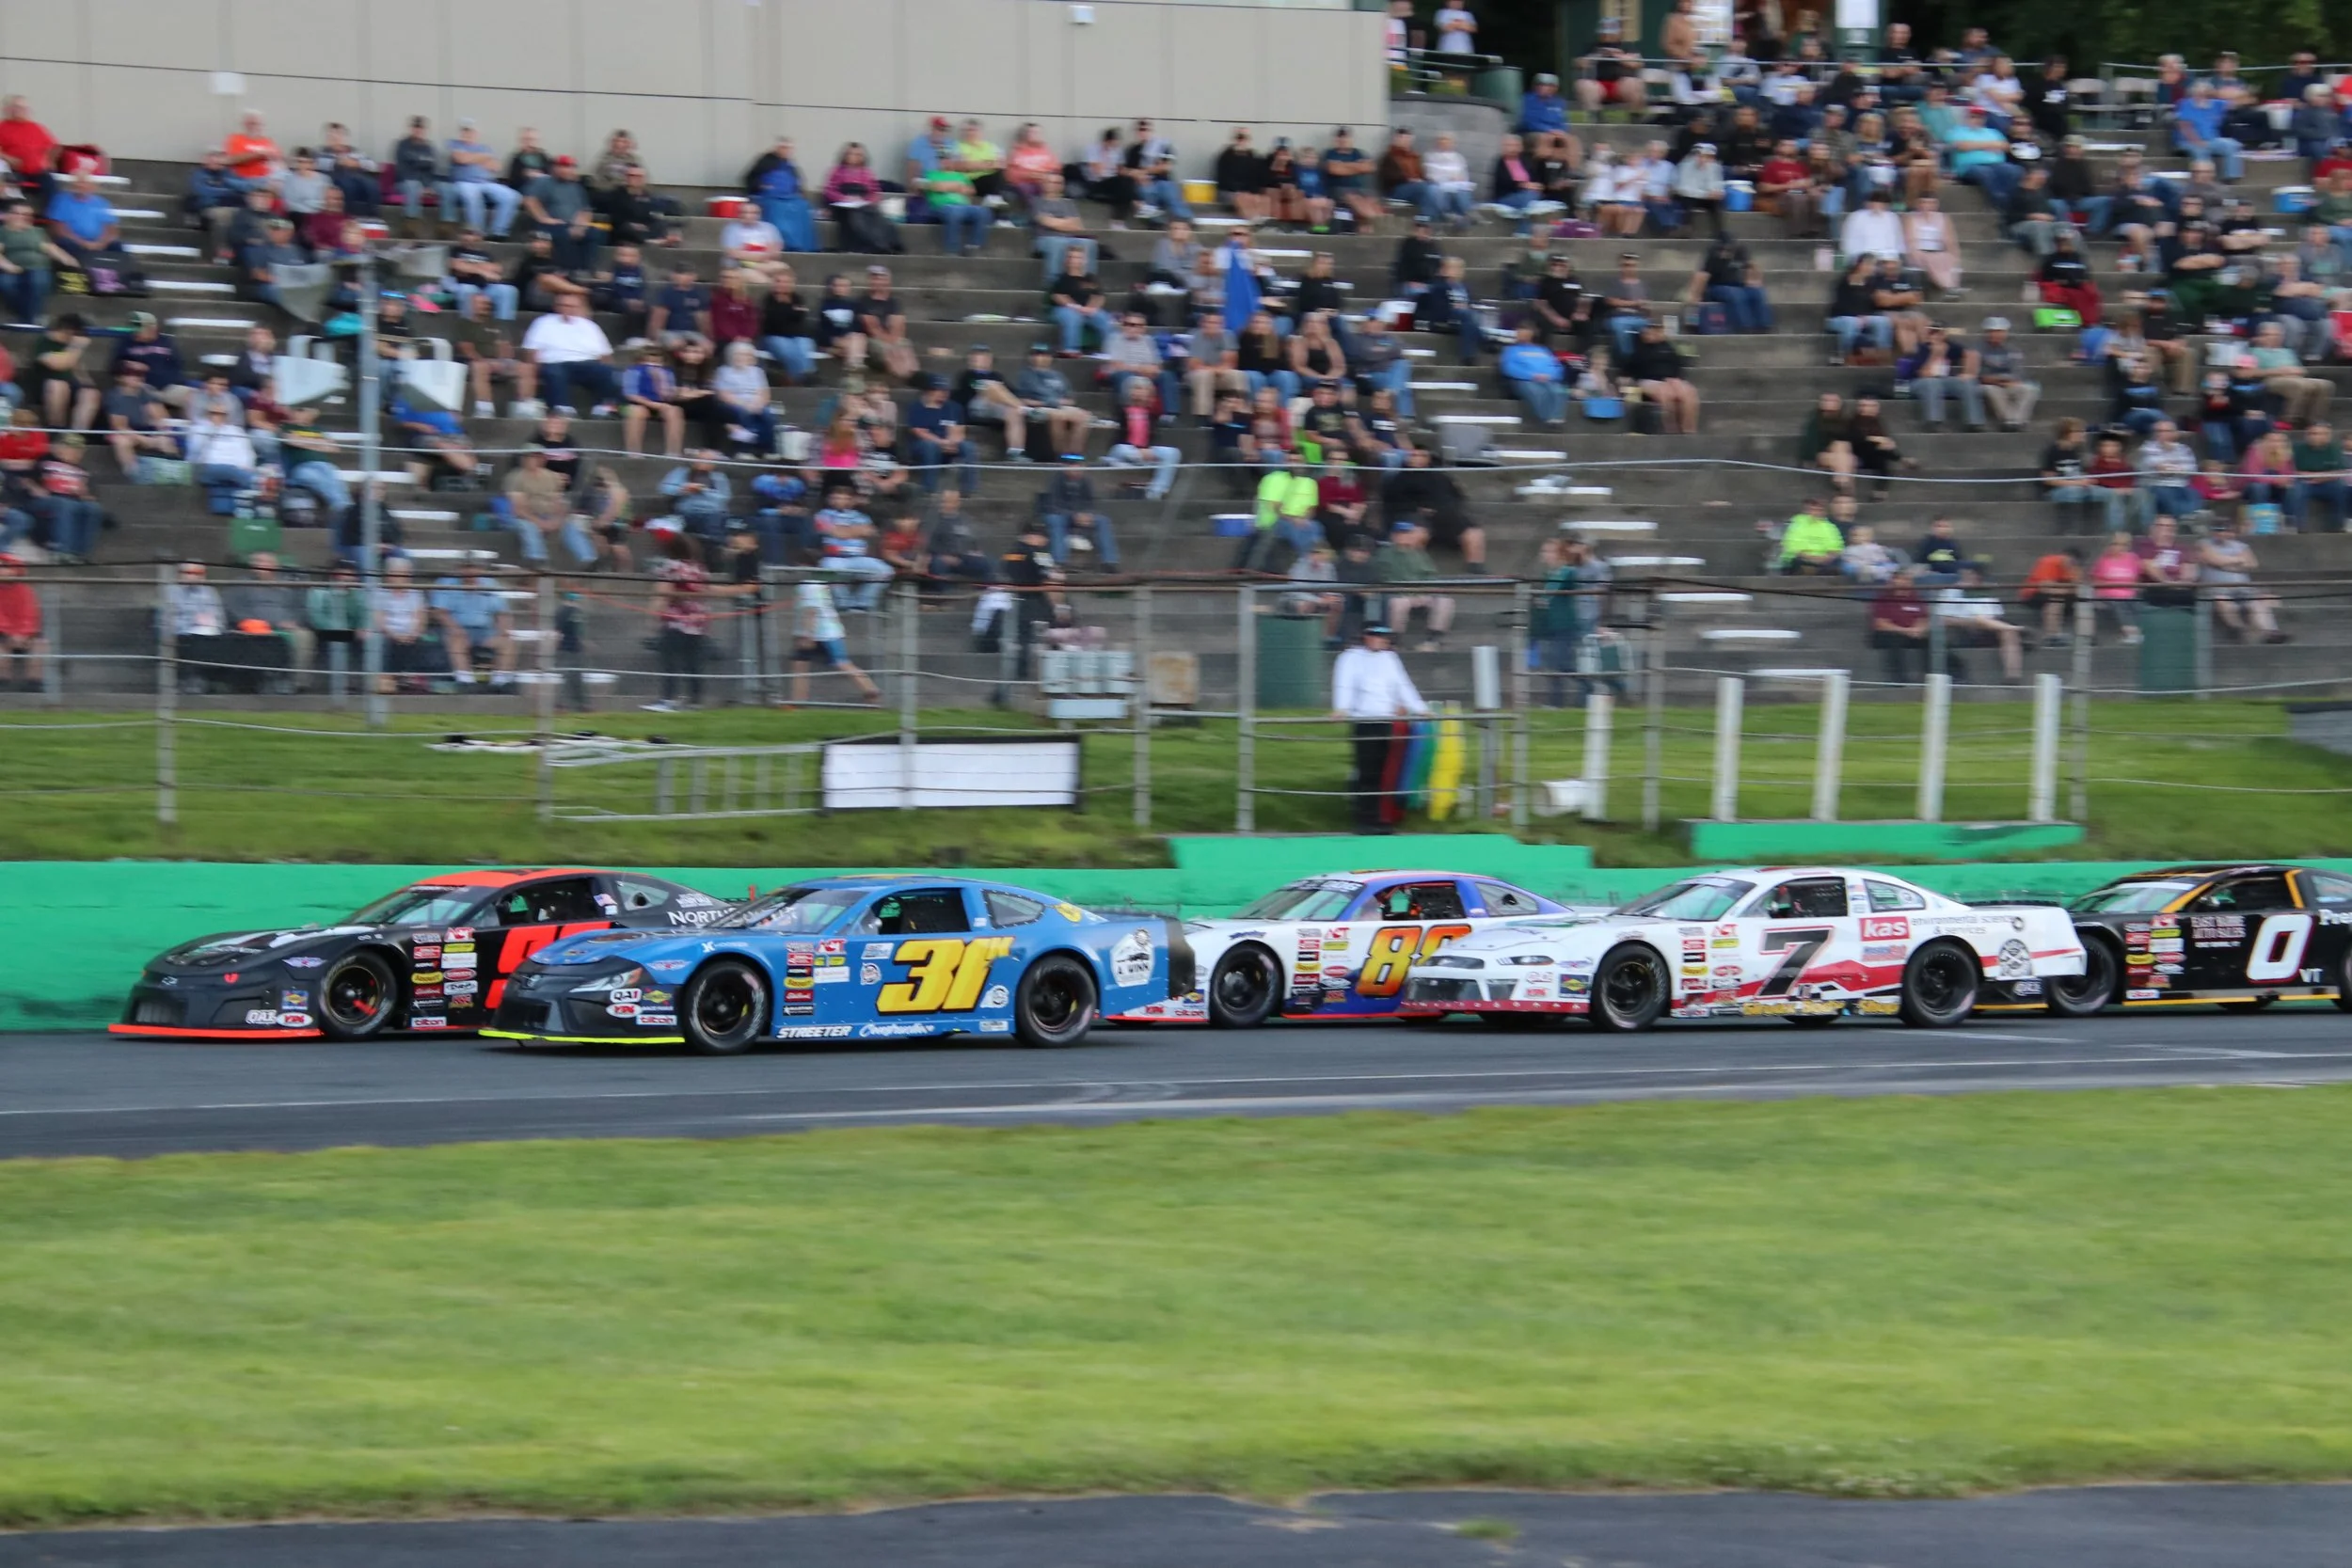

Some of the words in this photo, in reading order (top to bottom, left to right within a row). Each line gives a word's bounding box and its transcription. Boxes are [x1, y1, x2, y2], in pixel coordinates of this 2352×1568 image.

[1325, 927, 1350, 940] ACT
[1864, 919, 1908, 938] kas
[815, 939, 848, 954] ACT
[2246, 914, 2314, 984] 0
[1754, 926, 1835, 1000] 7
[2298, 967, 2322, 984] VT
[613, 990, 640, 1001] QA1
[776, 1025, 854, 1038] STREETER
